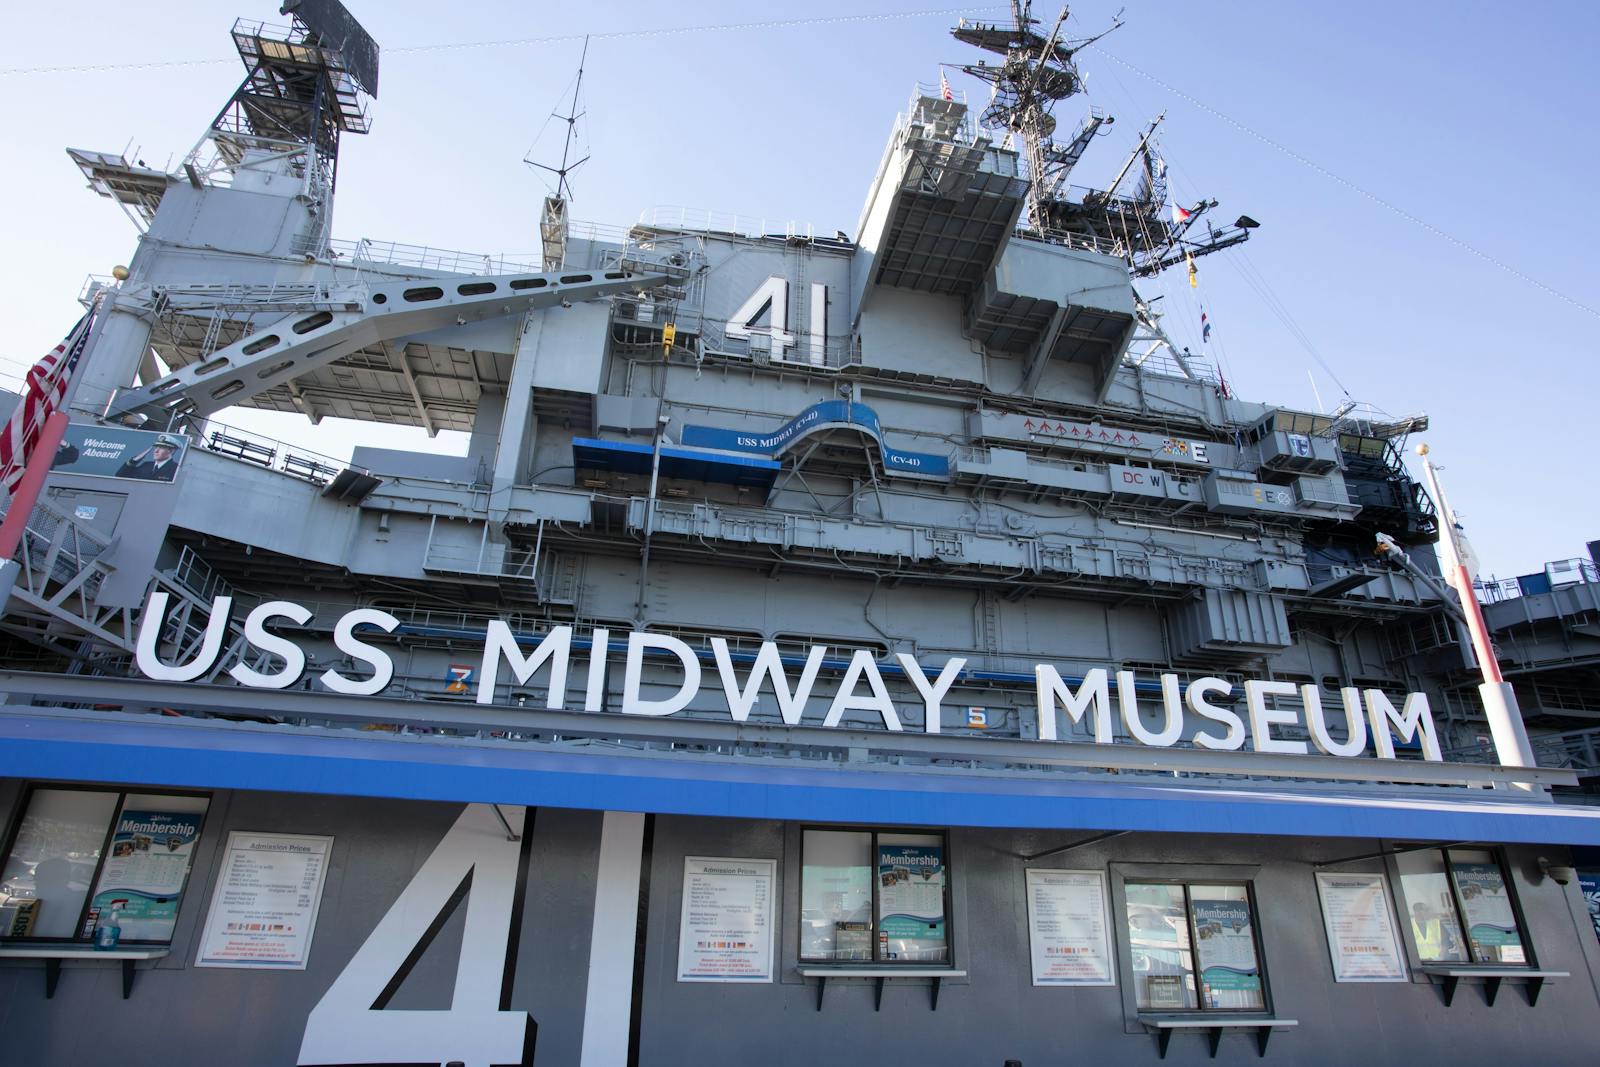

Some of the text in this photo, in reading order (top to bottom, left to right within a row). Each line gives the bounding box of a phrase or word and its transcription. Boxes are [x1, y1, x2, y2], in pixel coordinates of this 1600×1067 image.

[725, 274, 828, 366] 41
[83, 438, 126, 450] Welcome
[737, 437, 758, 447] USS
[760, 425, 794, 448] MIDWAY
[82, 448, 121, 459] Aboard!
[1190, 442, 1210, 463] E
[891, 455, 921, 467] (CV-41)
[1123, 471, 1160, 487] DC W
[136, 592, 1443, 762] USS MIDWAY MUSEUM
[450, 668, 471, 689] 7
[968, 706, 987, 725] 5
[120, 820, 196, 837] Membership
[249, 843, 311, 853] Admission Prices
[881, 853, 940, 868] Membership
[703, 866, 737, 875] Admission
[1456, 870, 1502, 883] Membership
[1196, 908, 1247, 921] Membership
[296, 802, 656, 1067] 41
